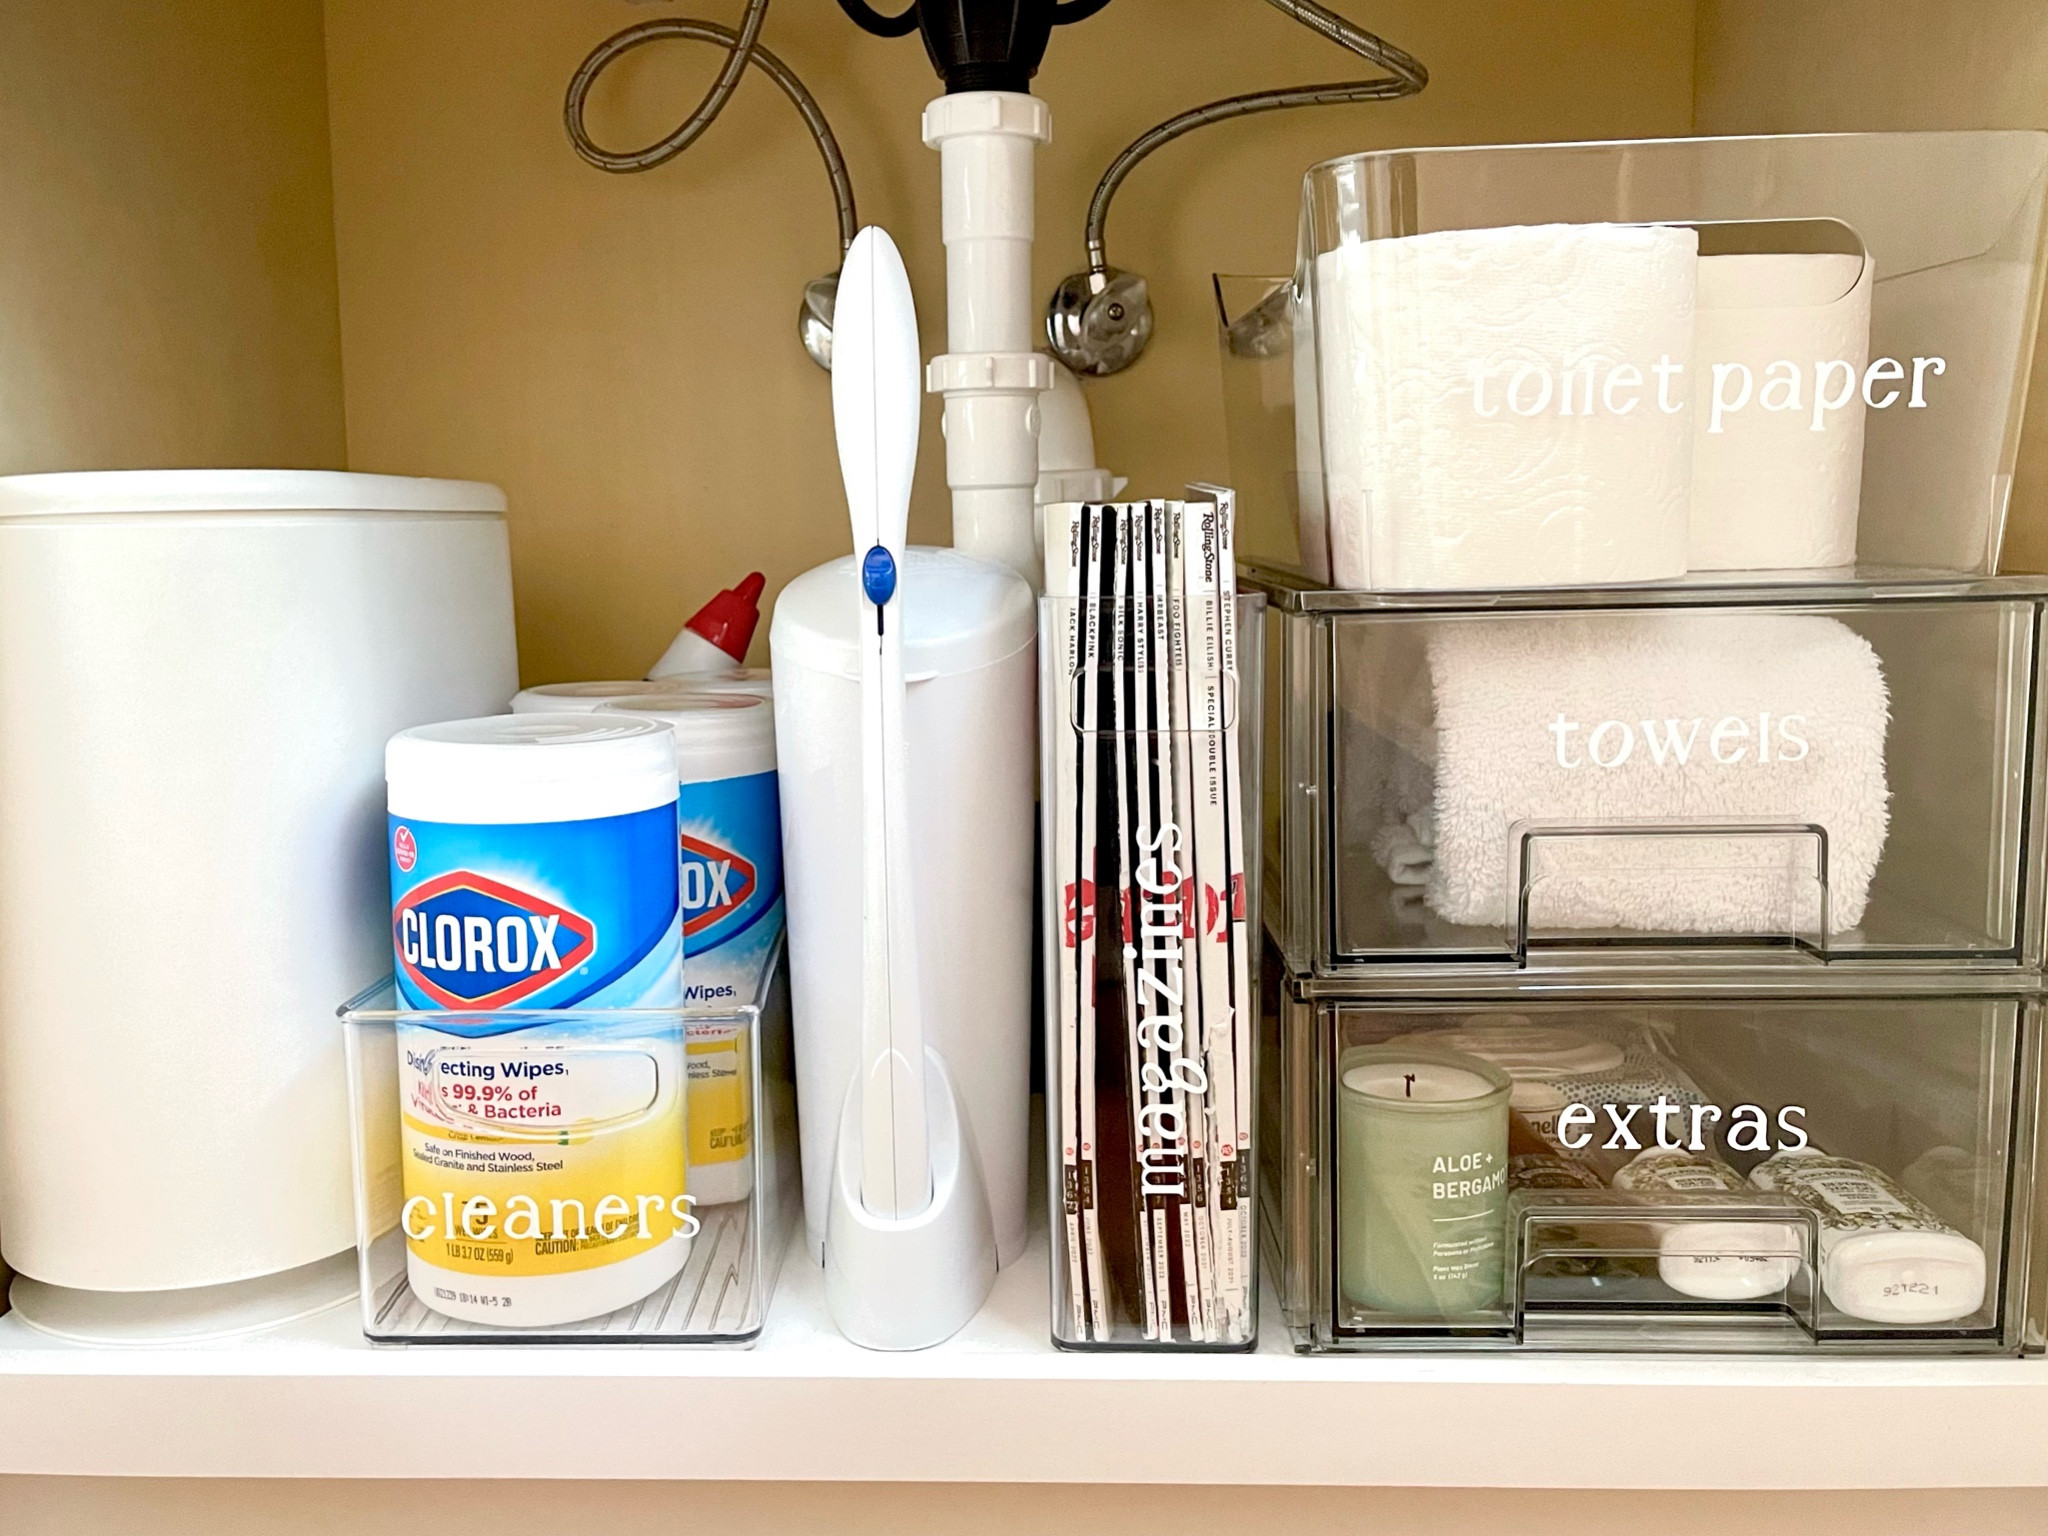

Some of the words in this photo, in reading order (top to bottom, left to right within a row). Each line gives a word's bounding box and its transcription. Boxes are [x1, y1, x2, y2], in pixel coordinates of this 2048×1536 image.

[1469, 353, 1685, 418] toilet
[1707, 356, 1947, 434] paper
[1172, 599, 1180, 619] FOO
[1205, 600, 1214, 632] BILLIE
[1223, 590, 1232, 635] STEPHEN
[1088, 603, 1096, 658] BLACKPINK
[1206, 636, 1215, 669] EILISH
[1224, 639, 1233, 671] CURRY
[1207, 685, 1216, 727] SPECIAL
[1208, 733, 1217, 772] DOUBLE
[1547, 711, 1810, 769] towels
[1209, 776, 1218, 806] ISSUE
[402, 908, 562, 974] CLOROX
[1123, 822, 1208, 1198] magazines
[453, 1083, 513, 1101] 99.9%
[519, 1085, 538, 1101] of
[485, 1102, 562, 1119] Bacteria
[1556, 1095, 1809, 1153] extras
[425, 1142, 441, 1155] Safe
[442, 1149, 454, 1157] on
[455, 1149, 496, 1161] Finished
[498, 1152, 535, 1162] Wood,
[434, 1155, 465, 1171] Granite
[466, 1161, 486, 1173] and
[488, 1164, 534, 1173] Stainless
[536, 1160, 564, 1171] Steel
[1432, 1152, 1483, 1173] ALOE
[401, 1192, 701, 1241] cleaners
[446, 1242, 450, 1256] 1
[451, 1243, 461, 1258] LB
[473, 1246, 486, 1261] OZ
[505, 1248, 514, 1266] g)
[535, 1239, 580, 1256] CAUTION:
[1156, 1217, 1164, 1258] SEPTEMBER
